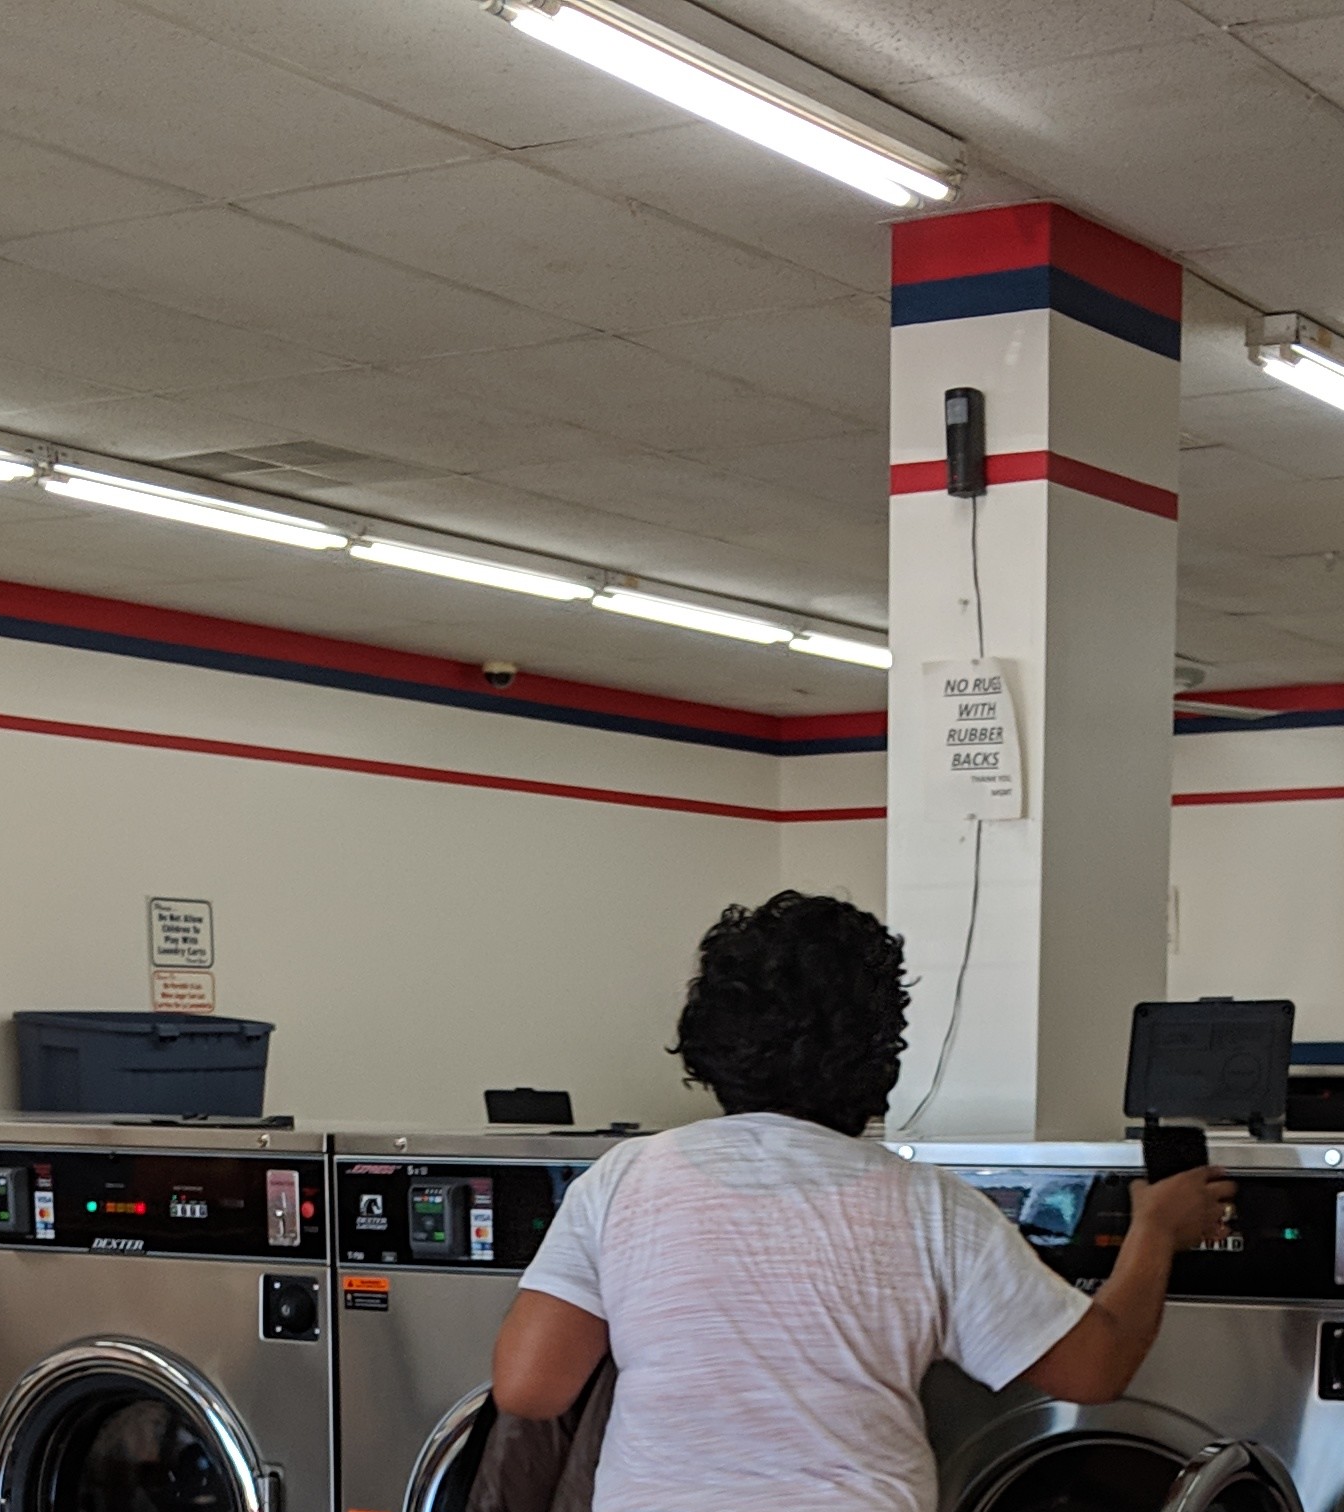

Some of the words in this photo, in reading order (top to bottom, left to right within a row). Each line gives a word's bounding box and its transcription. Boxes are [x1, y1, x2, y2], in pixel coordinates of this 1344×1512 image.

[945, 678, 969, 694] NO
[958, 702, 997, 718] WITH
[947, 727, 1004, 743] RUBBER
[951, 752, 1000, 768] BACKS
[91, 1237, 146, 1250] DEXTER
